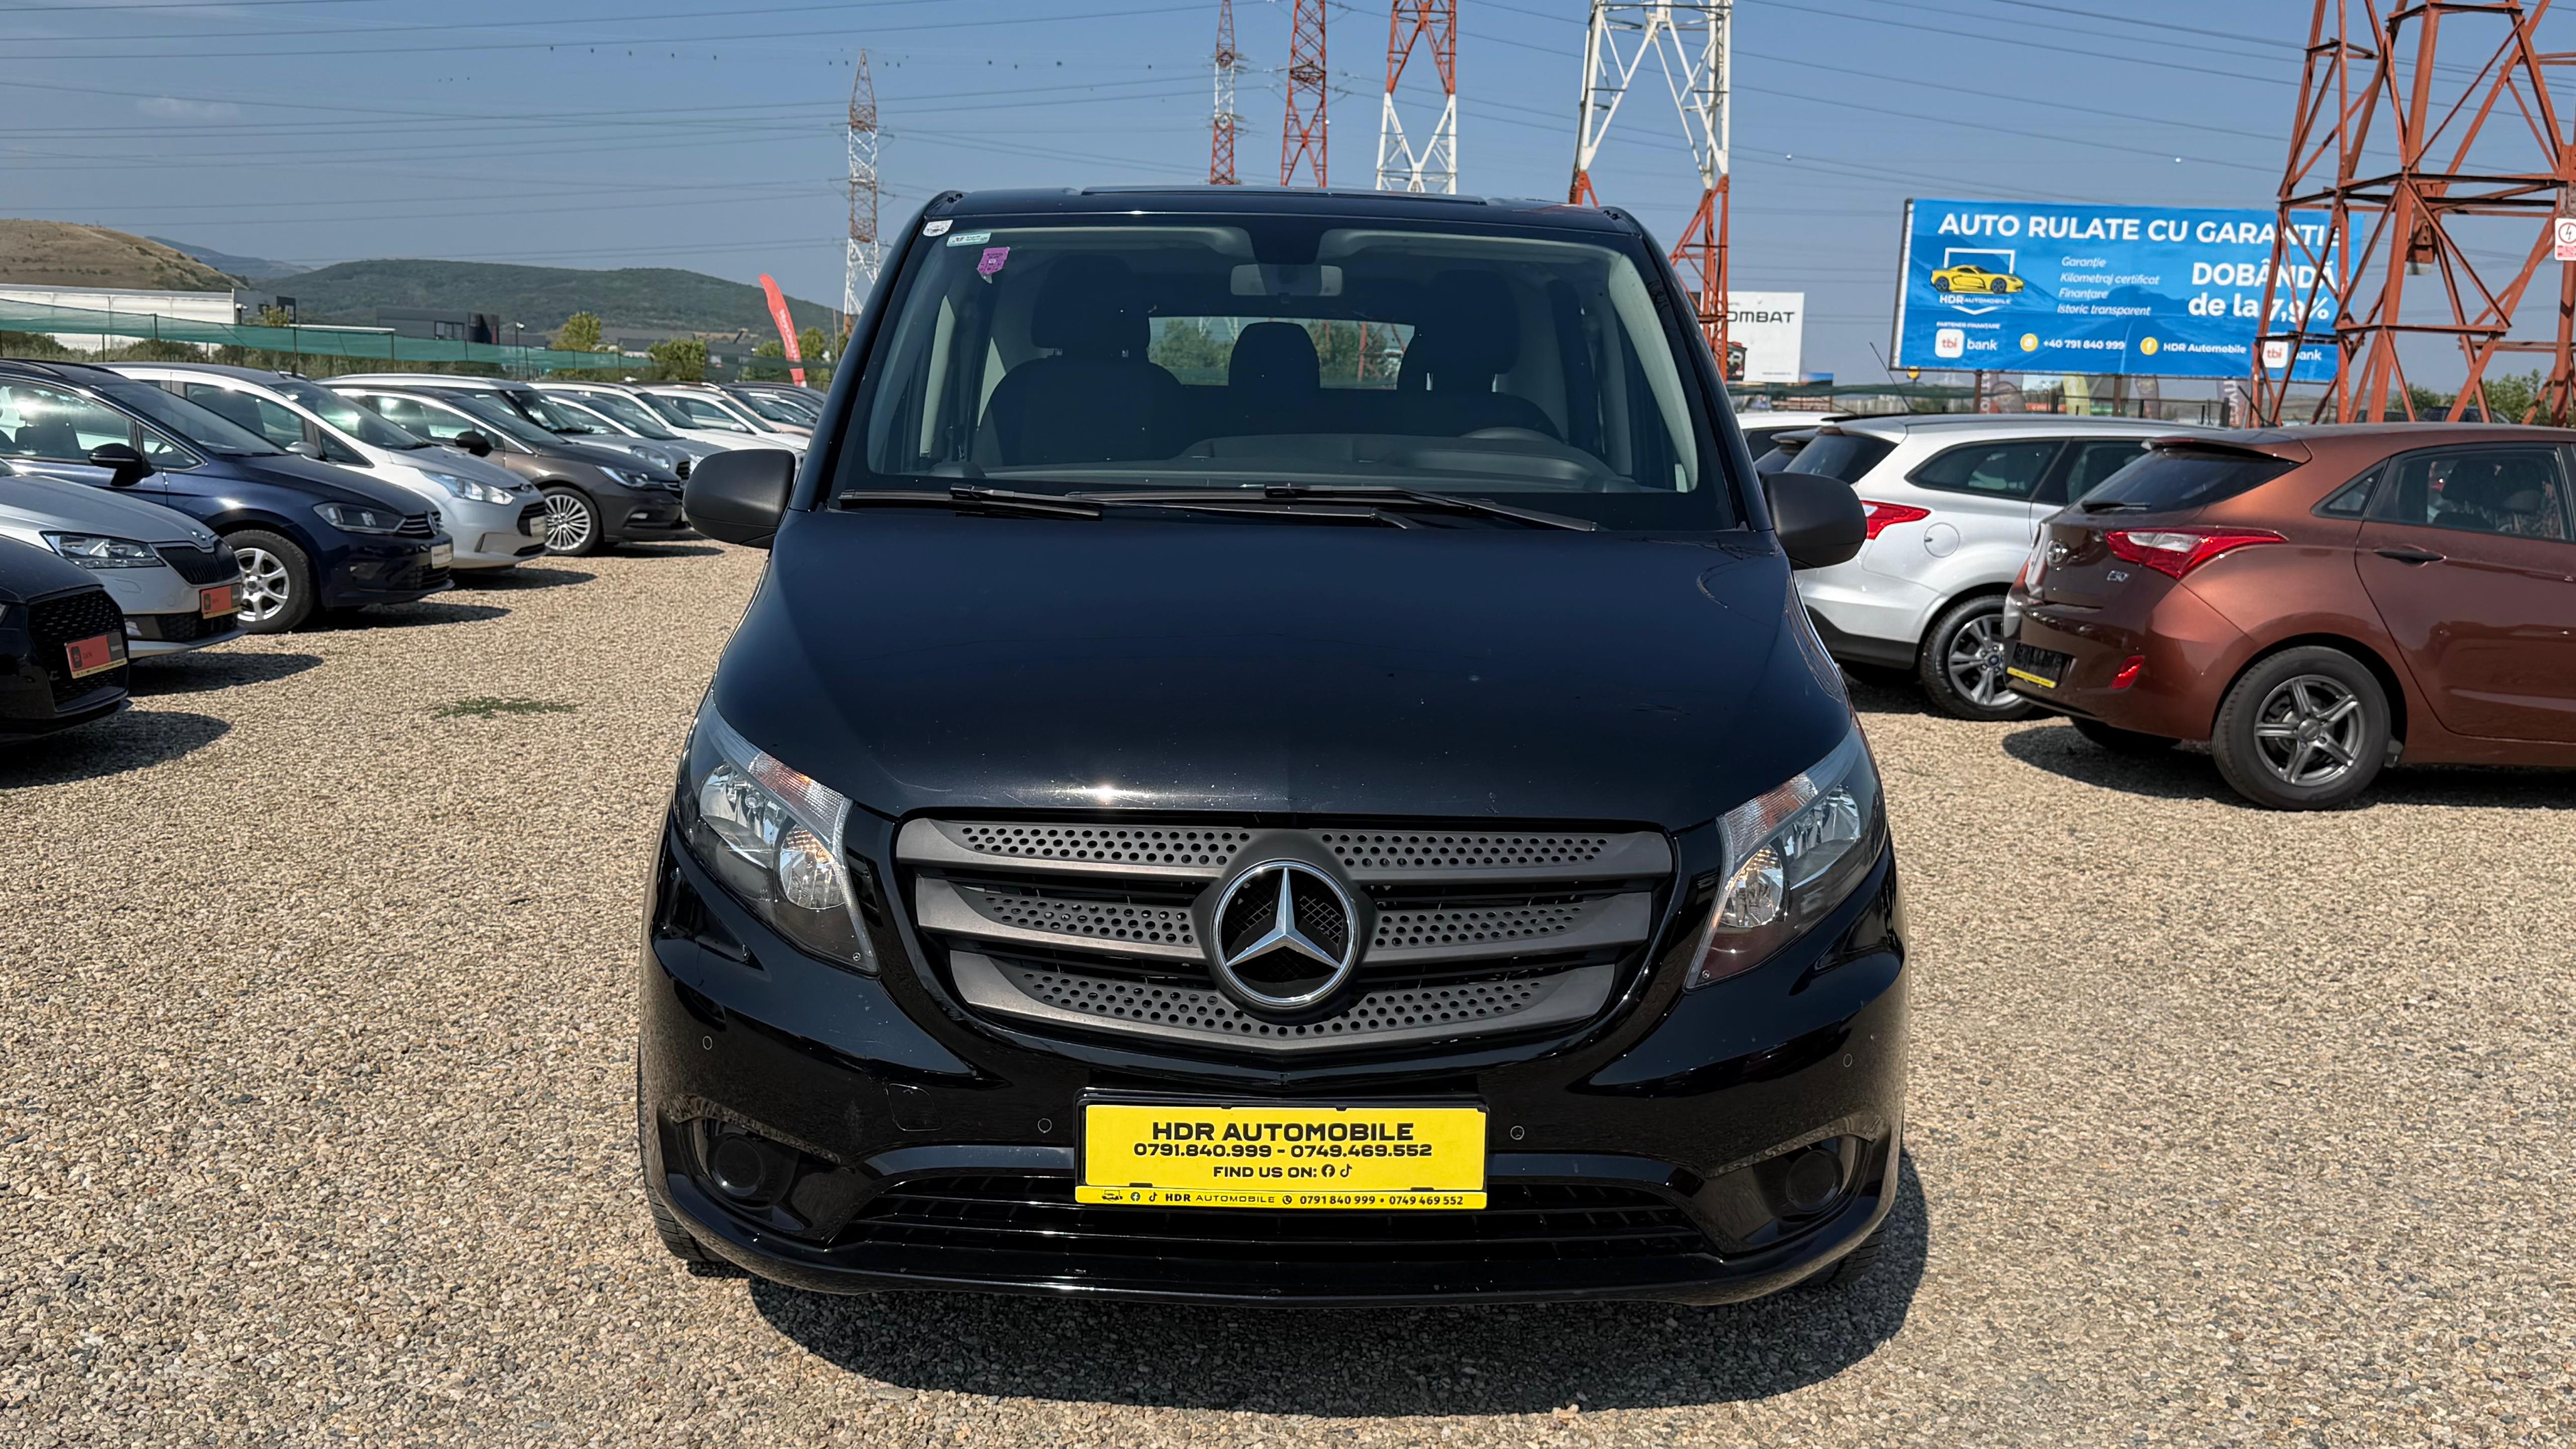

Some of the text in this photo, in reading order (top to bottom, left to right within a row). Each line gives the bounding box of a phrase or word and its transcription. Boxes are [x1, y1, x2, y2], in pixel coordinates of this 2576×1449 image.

[1938, 213, 2020, 236] AUTO
[2028, 216, 2140, 240] RULATE
[2147, 219, 2188, 242] CU
[2060, 272, 2160, 286] Kilometraj certificat
[2192, 258, 2336, 289] DOBÂNDĂ
[1940, 294, 1964, 304] HDR
[2057, 303, 2151, 317] Istoric transparent
[2188, 292, 2329, 323] de la 7,9%
[1727, 311, 1795, 323] OMBAT
[1942, 338, 1998, 351] tbi bank
[2043, 339, 2125, 350] +40 791 840 999
[2163, 343, 2246, 354] HDR Automobile
[2296, 349, 2322, 361] ank
[1153, 1122, 1414, 1141] HDR AUTOMOBILE
[1134, 1143, 1271, 1157] 0791.840.999
[1291, 1144, 1432, 1157] 0749.469.552
[1214, 1166, 1317, 1178] FIND US ON:
[1165, 1193, 1463, 1205] HDR AUTOMOBILE 0791 840 999 0749 469 552
